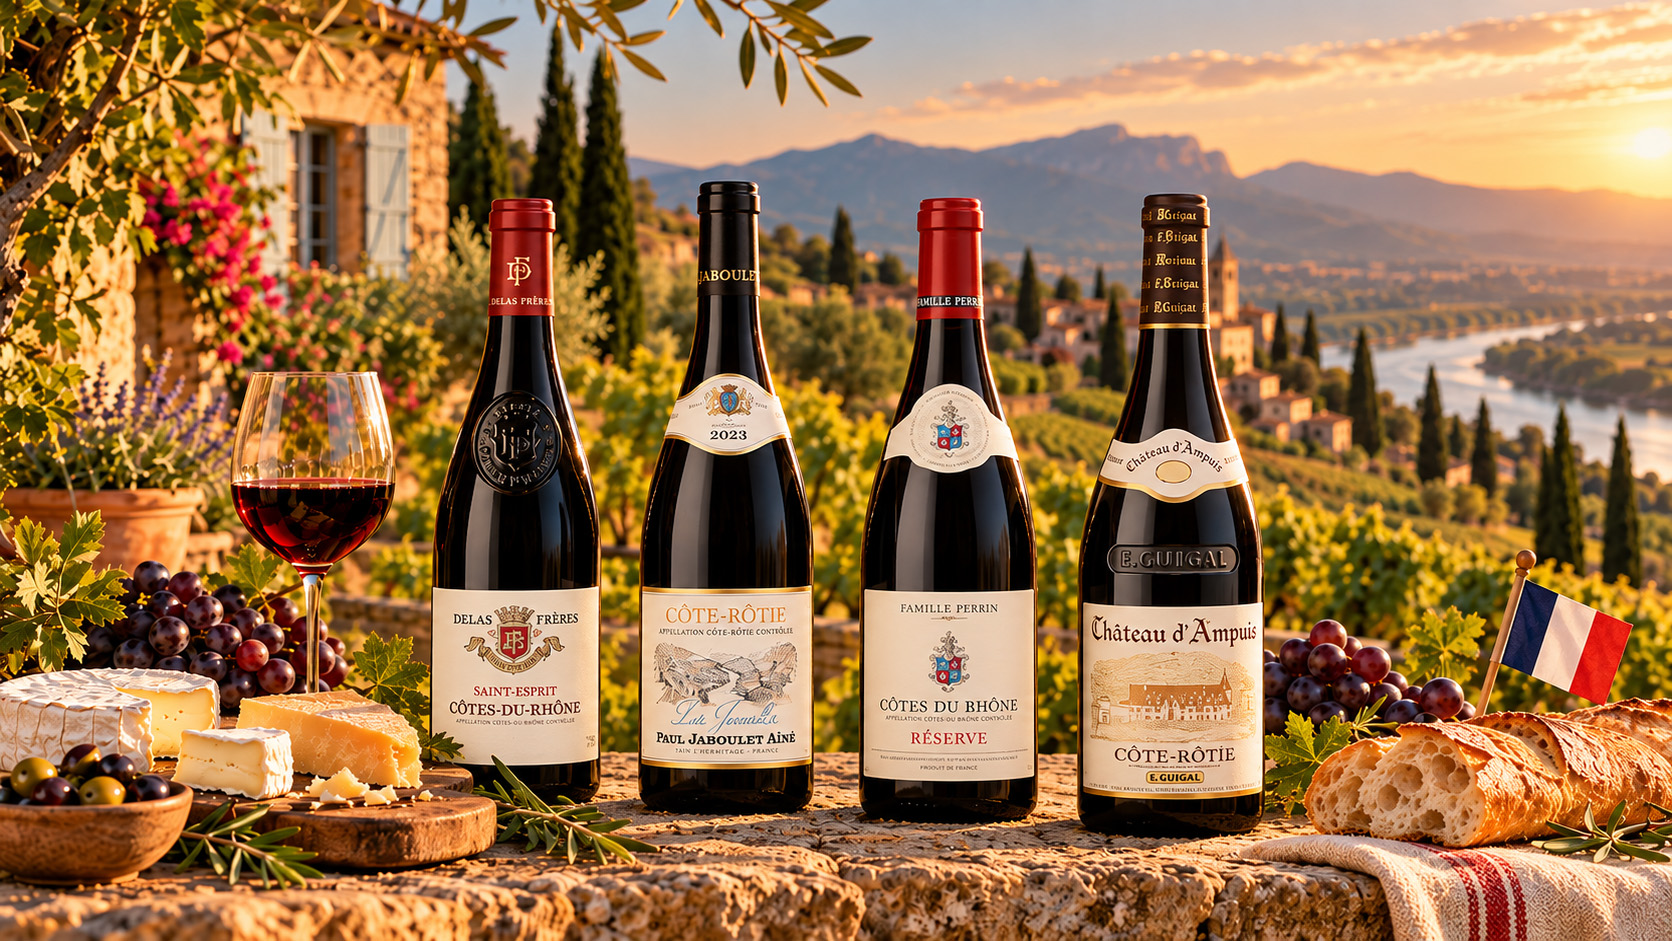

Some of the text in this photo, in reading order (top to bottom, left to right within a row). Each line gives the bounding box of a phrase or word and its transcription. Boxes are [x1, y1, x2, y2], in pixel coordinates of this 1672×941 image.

[710, 430, 748, 440] 2023
[1126, 445, 1170, 472] Château
[665, 603, 787, 624] CÔTE-RÔTIE
[900, 603, 998, 613] FAMILLE PERRIN
[453, 611, 579, 625] DELAS FRÈRES
[1091, 615, 1167, 643] Château
[473, 685, 558, 697] SAINT-ESPRIT
[449, 699, 581, 716] CÔTES-DU-RHÔNE
[879, 696, 928, 713] CÔTES
[934, 700, 959, 713] DU
[656, 731, 685, 745] PAUL
[688, 733, 764, 745] JABOULET
[910, 729, 988, 745] RÉSERVE
